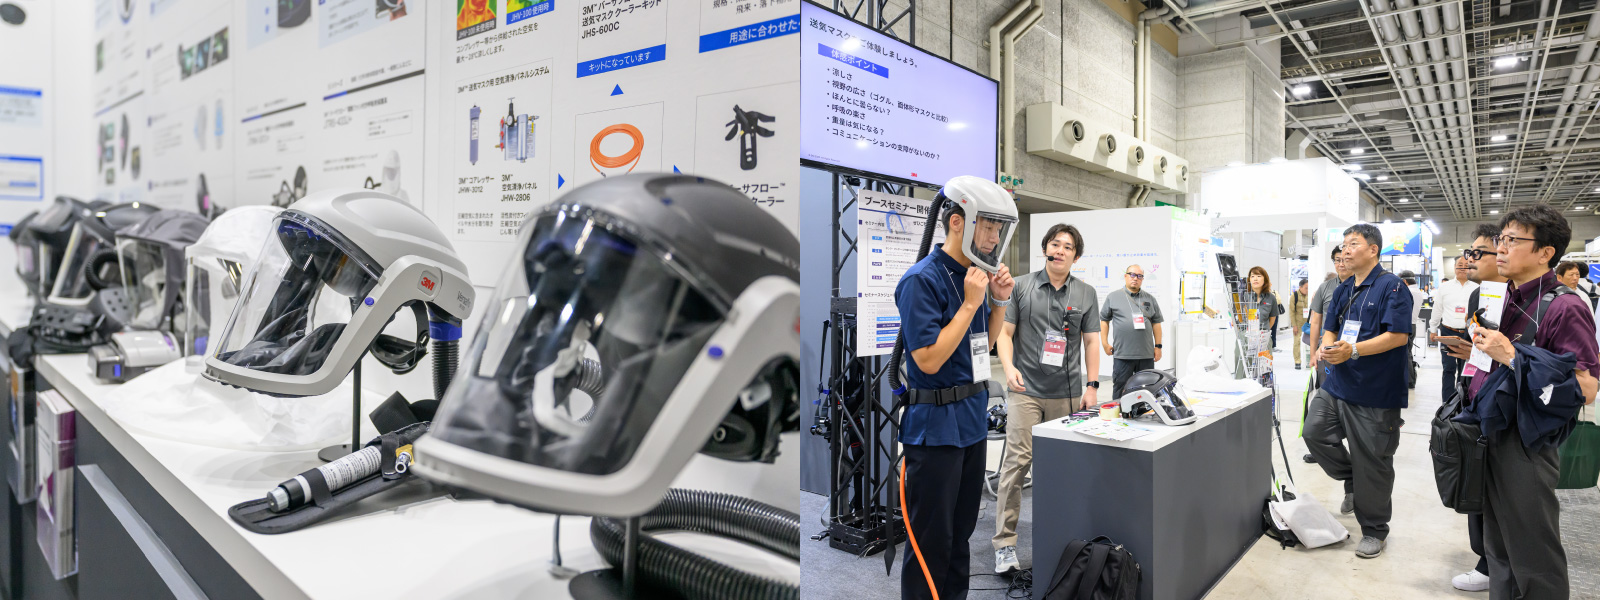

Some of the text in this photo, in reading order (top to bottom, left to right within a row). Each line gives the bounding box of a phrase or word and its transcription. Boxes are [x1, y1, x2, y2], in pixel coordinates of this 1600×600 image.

[581, 21, 620, 39] JHS-600C
[729, 18, 800, 44] 用途に合わせた
[809, 17, 918, 68] 送気マスクご体験しましょう。
[588, 51, 652, 72] キットになっています
[501, 193, 531, 202] JHW-2806
[421, 277, 435, 291] 3M
